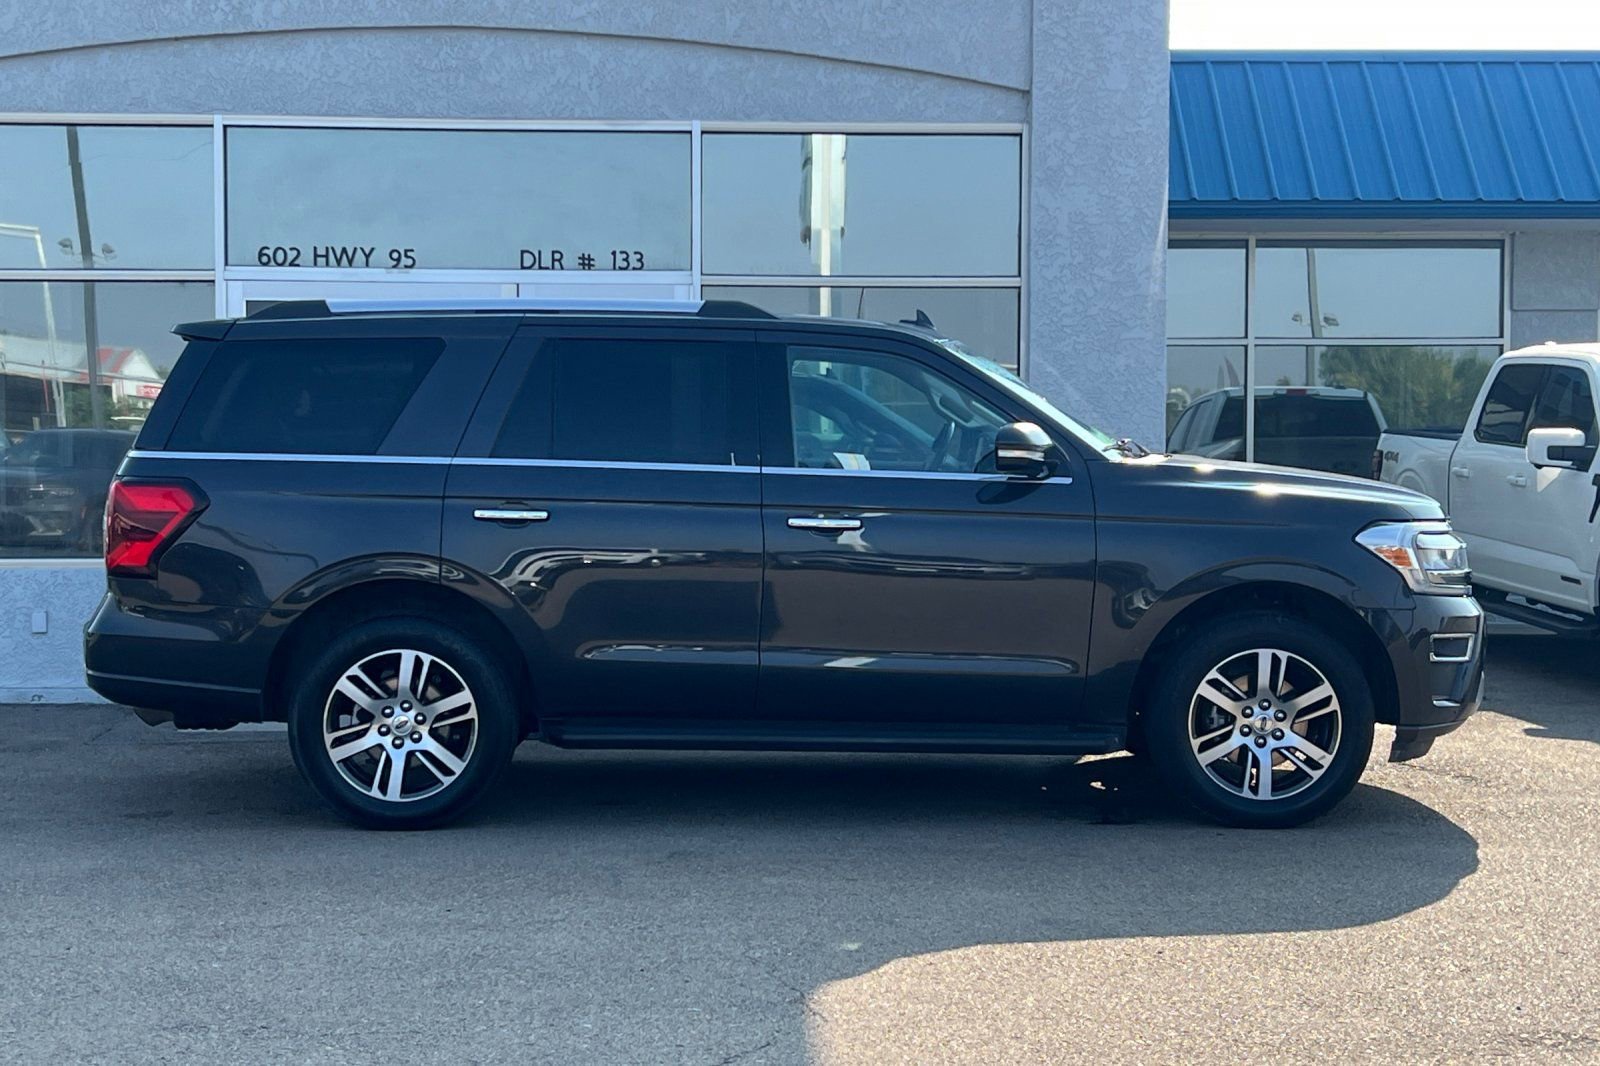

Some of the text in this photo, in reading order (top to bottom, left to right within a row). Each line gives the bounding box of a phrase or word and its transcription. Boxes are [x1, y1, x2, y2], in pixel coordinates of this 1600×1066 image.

[257, 245, 417, 269] 602 HWY 95
[520, 250, 645, 270] DLR # 133
